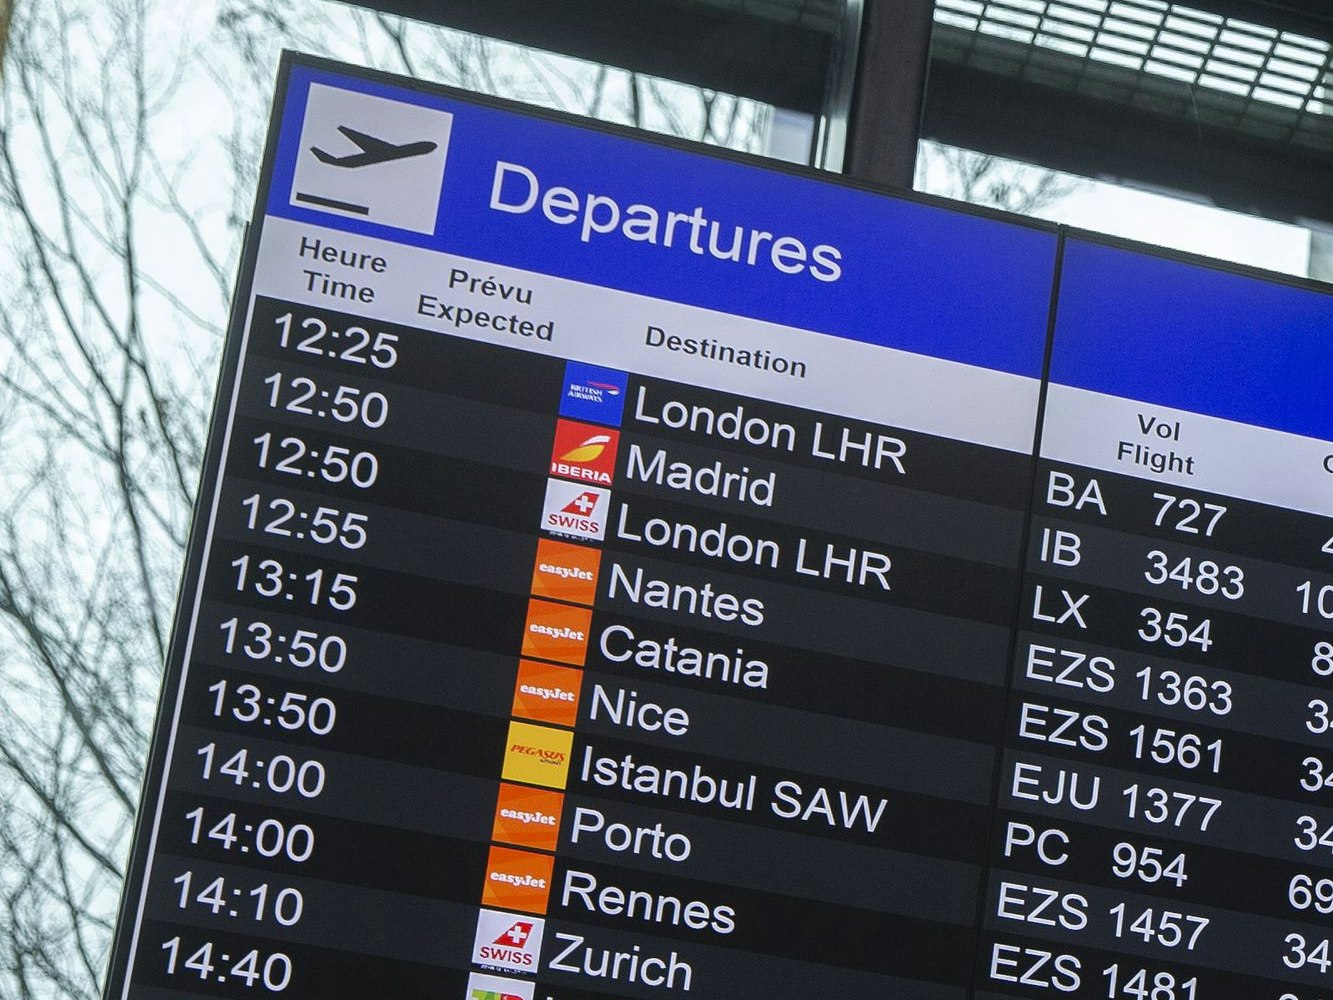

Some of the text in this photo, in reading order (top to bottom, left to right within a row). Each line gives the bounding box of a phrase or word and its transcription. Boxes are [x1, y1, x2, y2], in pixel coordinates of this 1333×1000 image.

[490, 161, 841, 281] Departures
[300, 237, 386, 272] Heure
[304, 270, 374, 303] Time
[449, 269, 532, 304] Prévu
[418, 295, 554, 341] Expected
[646, 326, 805, 378] Destination
[276, 313, 398, 368] 12:25
[636, 386, 795, 451] London
[813, 423, 906, 474] LHR
[1047, 471, 1107, 515] BA
[1154, 493, 1226, 536] 727
[1138, 414, 1180, 441] Vol
[552, 463, 611, 483] IBERIA
[1118, 441, 1194, 475] Flight
[265, 373, 388, 427] 12:50
[627, 445, 775, 506] Madrid
[1041, 528, 1080, 566] IB
[1145, 551, 1244, 599] 3483
[254, 433, 378, 487] 12:50
[618, 503, 779, 568] London
[796, 539, 891, 590] LHR
[1033, 586, 1089, 628] LX
[1138, 608, 1212, 651] 354
[548, 513, 600, 533] SWISS
[539, 564, 593, 580] easyJet
[243, 494, 368, 549] 12:55
[609, 564, 764, 625] Nantes
[1027, 644, 1115, 692] EZS
[1137, 667, 1232, 715] 1363
[232, 555, 357, 610] 13:15
[601, 625, 768, 688] Catania
[1020, 703, 1108, 751] EZS
[1130, 725, 1221, 773] 1561
[511, 744, 565, 761] PEGASUS
[209, 680, 336, 734] 13:50
[582, 746, 756, 810] Istanbul
[772, 781, 888, 832] SAW
[1005, 822, 1069, 865] PC
[1113, 843, 1187, 887] 954
[198, 743, 325, 797] 14:00
[572, 807, 690, 861] Porto
[998, 882, 1088, 930] EZS
[1110, 903, 1209, 950] 1457
[175, 871, 303, 925] 14:10
[549, 933, 691, 990] Zurich
[162, 937, 291, 991] 14:40
